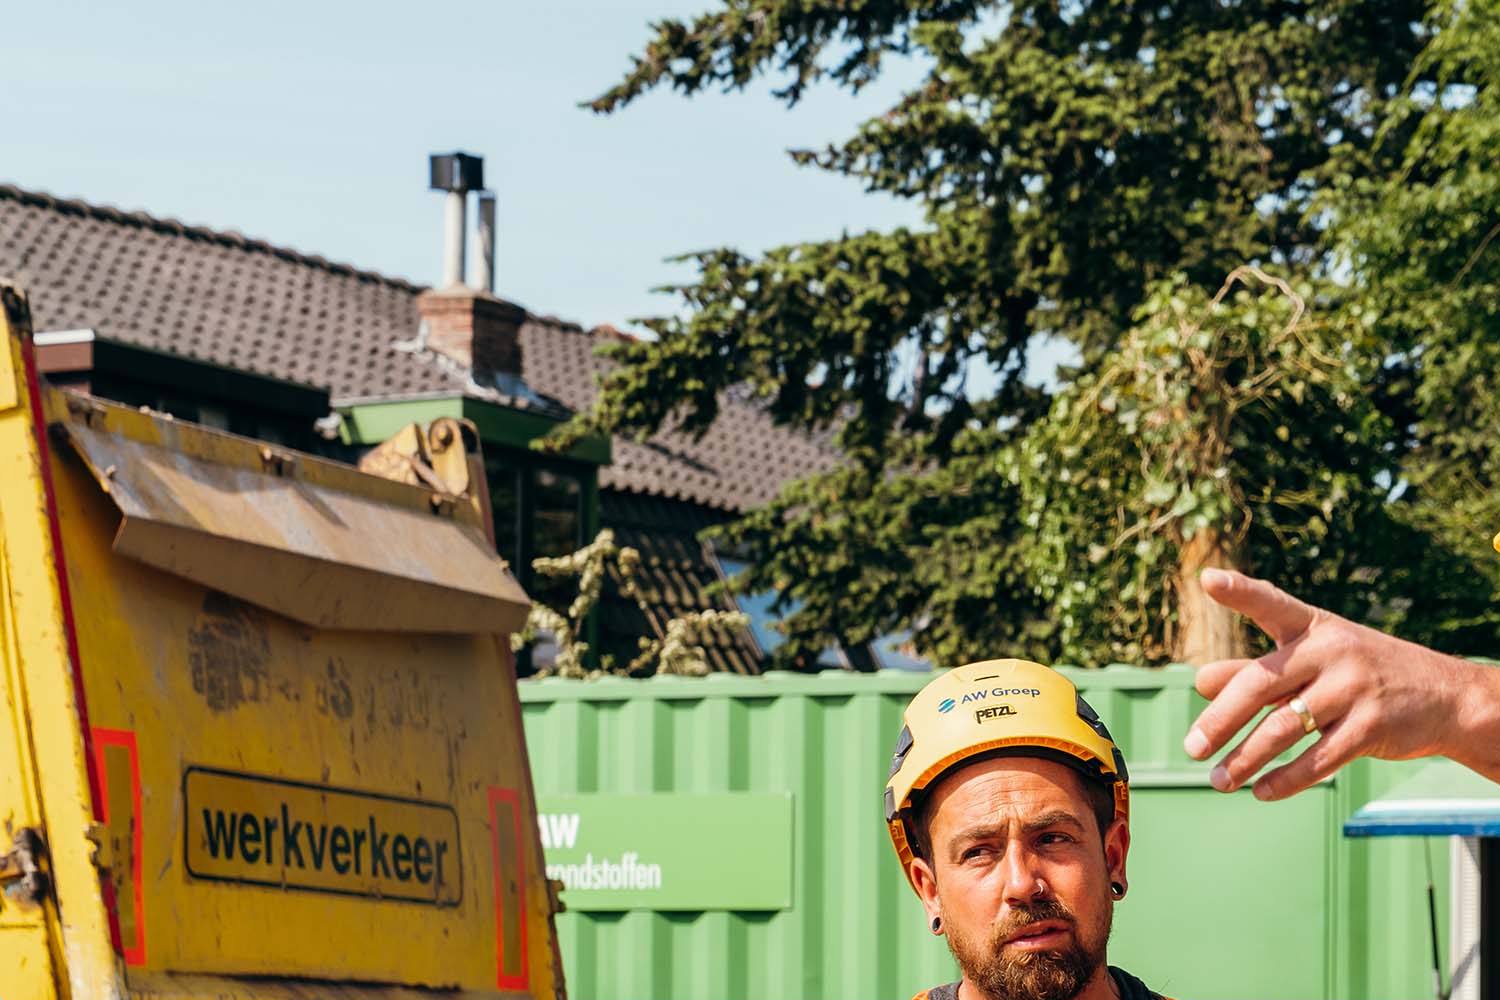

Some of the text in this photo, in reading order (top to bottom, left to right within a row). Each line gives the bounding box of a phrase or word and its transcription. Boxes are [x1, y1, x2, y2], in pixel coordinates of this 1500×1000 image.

[961, 687, 1041, 704] AW Groep
[976, 705, 1018, 724] PETZL
[203, 801, 447, 884] werkverkeer
